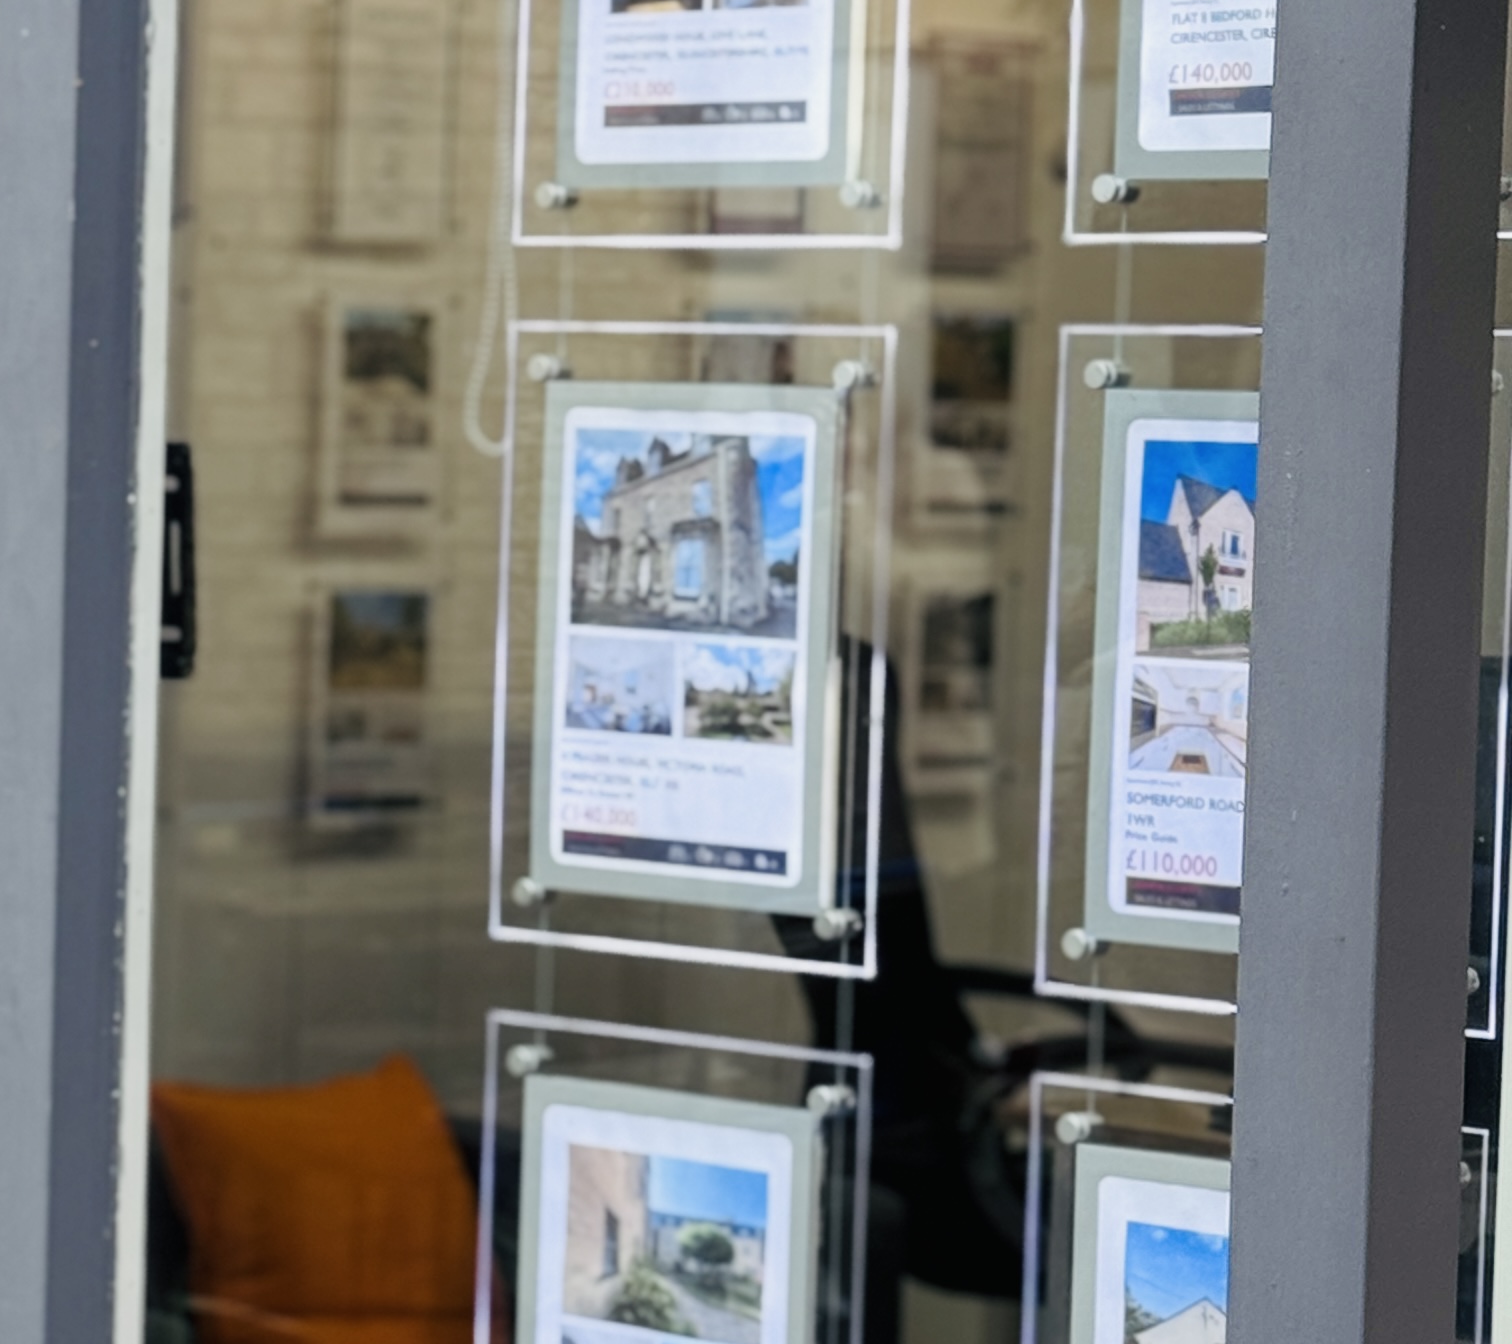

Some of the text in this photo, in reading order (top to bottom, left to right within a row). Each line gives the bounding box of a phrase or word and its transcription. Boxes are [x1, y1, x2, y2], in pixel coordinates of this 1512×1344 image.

[1210, 7, 1262, 23] BEDFORD
[1168, 61, 1253, 84] £140,000
[1126, 791, 1205, 810] SOMERFORD
[1125, 848, 1217, 877] £110,000
